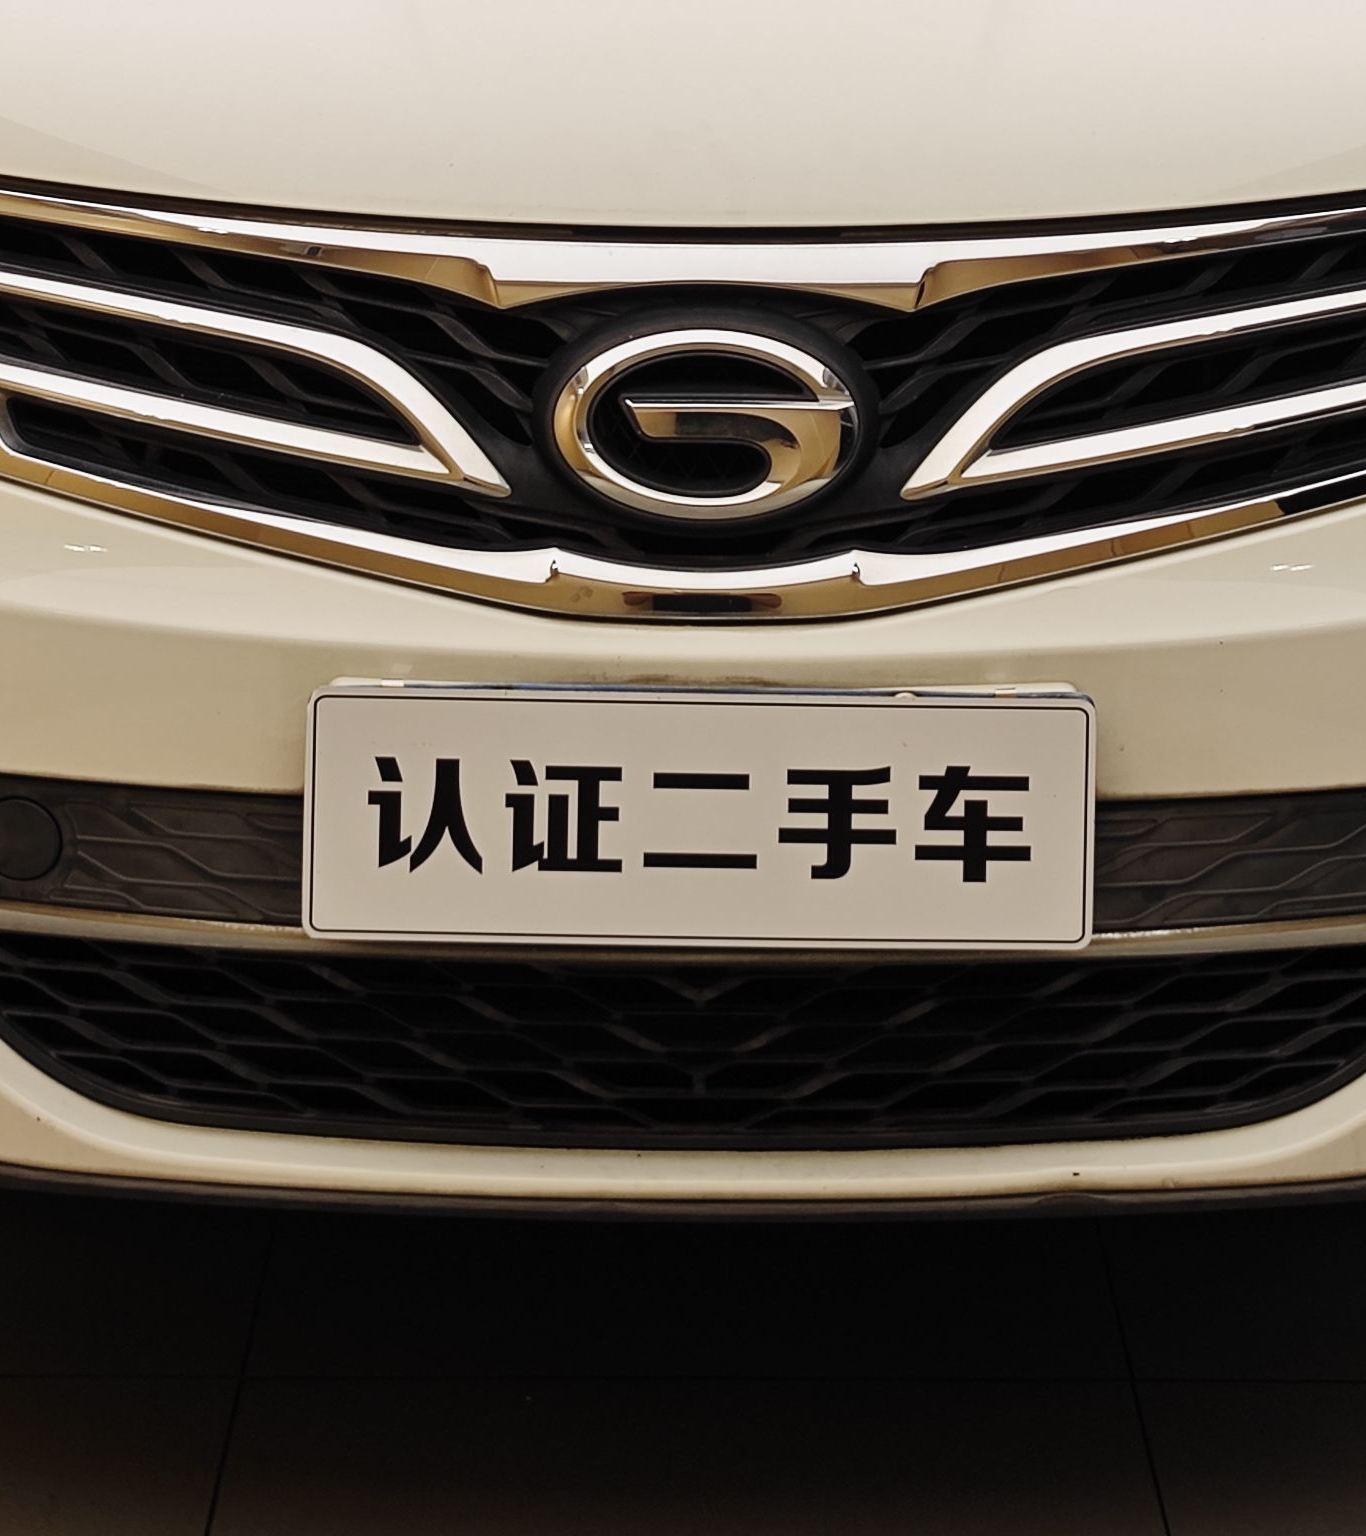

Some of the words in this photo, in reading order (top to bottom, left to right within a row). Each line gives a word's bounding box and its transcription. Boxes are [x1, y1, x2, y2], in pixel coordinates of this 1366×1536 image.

[366, 755, 1033, 883] 认证二手车
